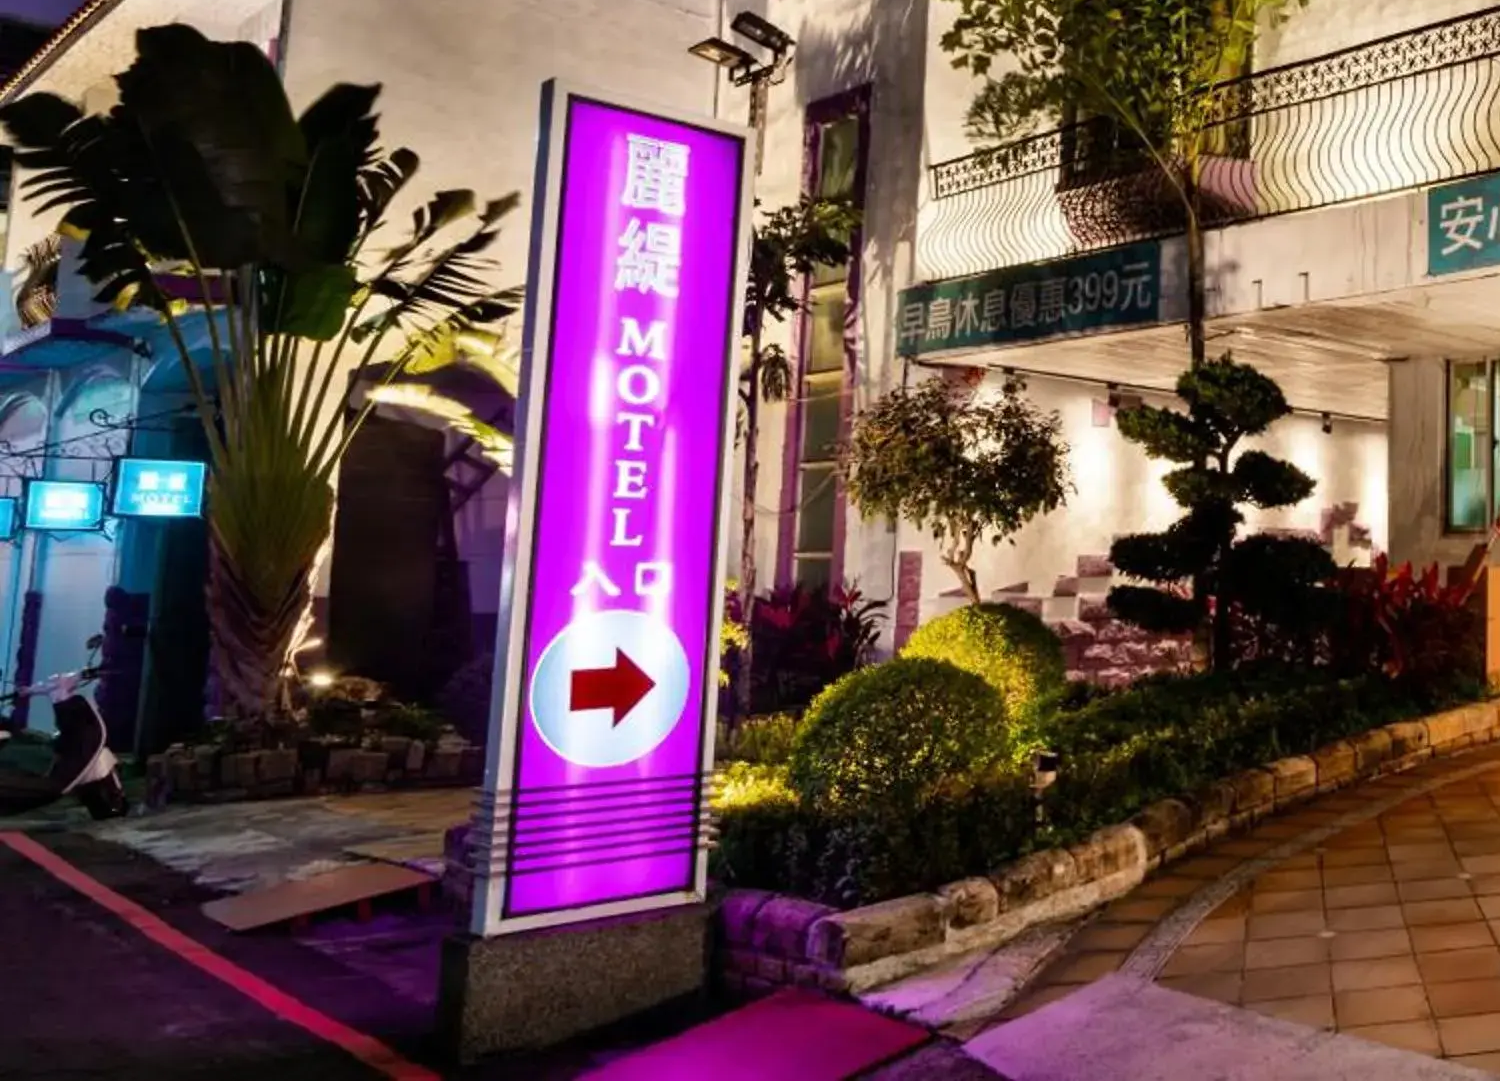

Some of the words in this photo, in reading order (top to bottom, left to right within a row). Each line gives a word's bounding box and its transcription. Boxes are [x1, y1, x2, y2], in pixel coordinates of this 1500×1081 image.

[615, 133, 690, 297] 麗緹
[900, 261, 1153, 345] 早鳥休息優惠399元
[610, 317, 667, 546] MOTEL
[570, 561, 673, 597] 入口
